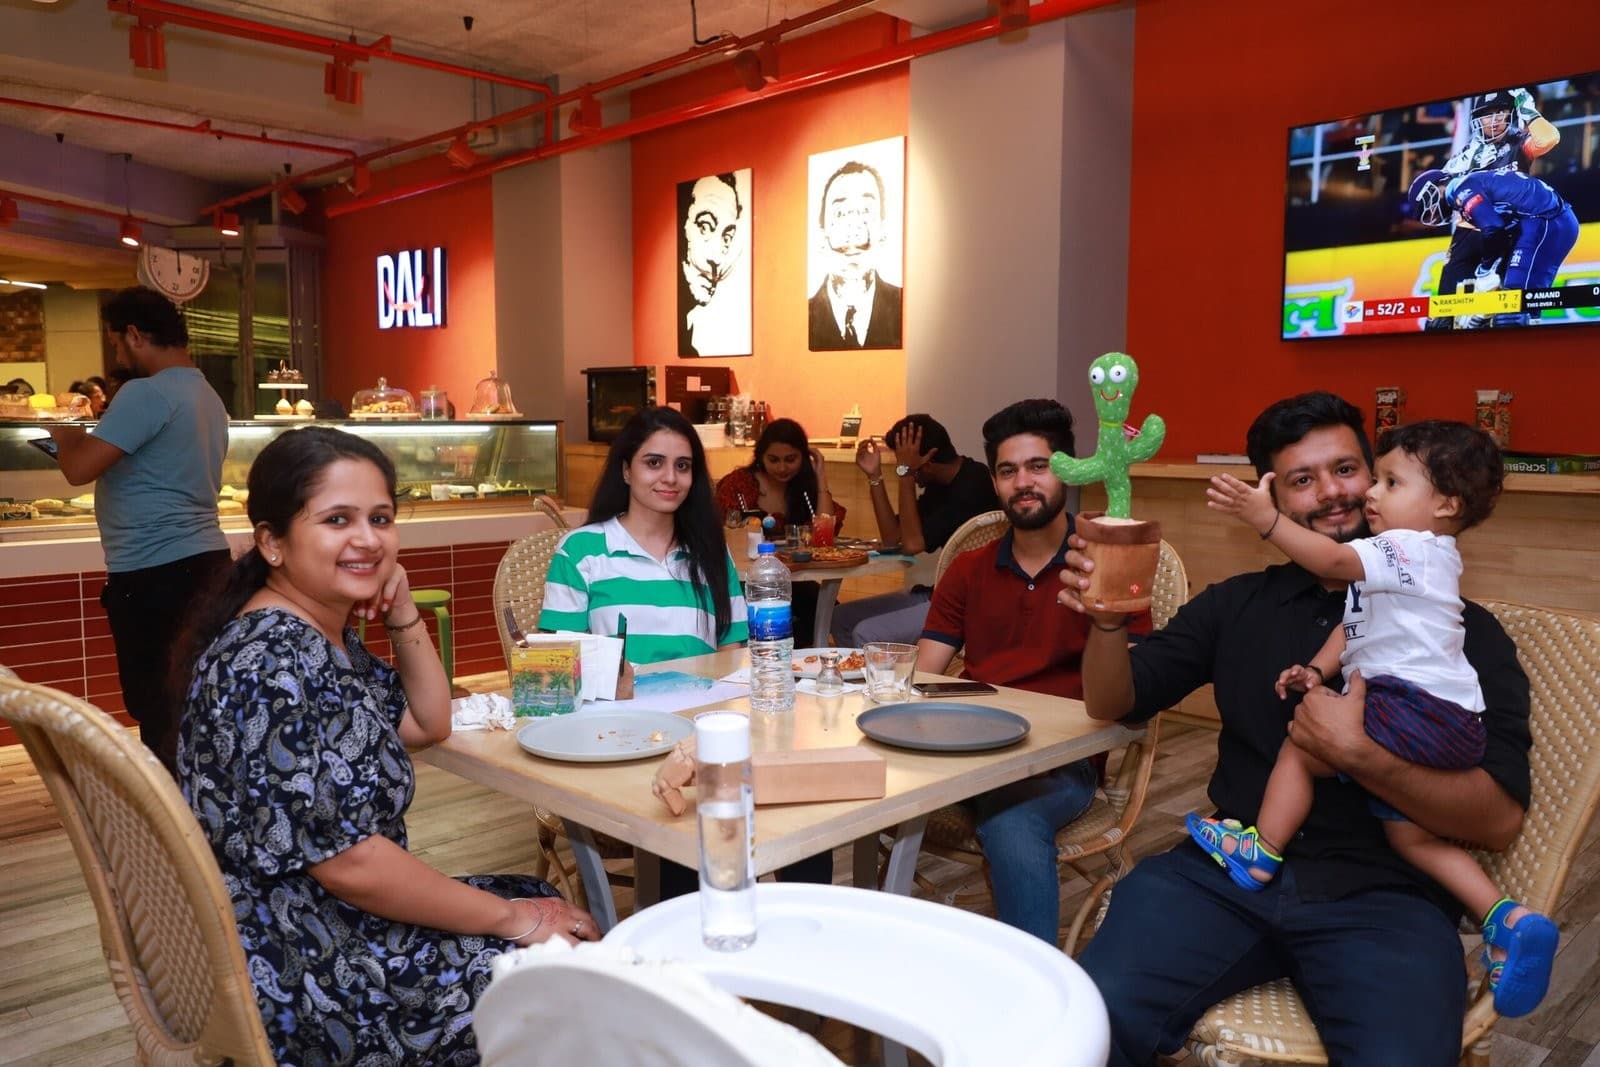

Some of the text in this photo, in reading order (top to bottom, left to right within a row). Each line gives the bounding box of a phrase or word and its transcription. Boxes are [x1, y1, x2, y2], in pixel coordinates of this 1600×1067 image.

[377, 247, 442, 328] DALI
[1533, 291, 1560, 299] ANAND
[1377, 303, 1405, 315] 52/2
